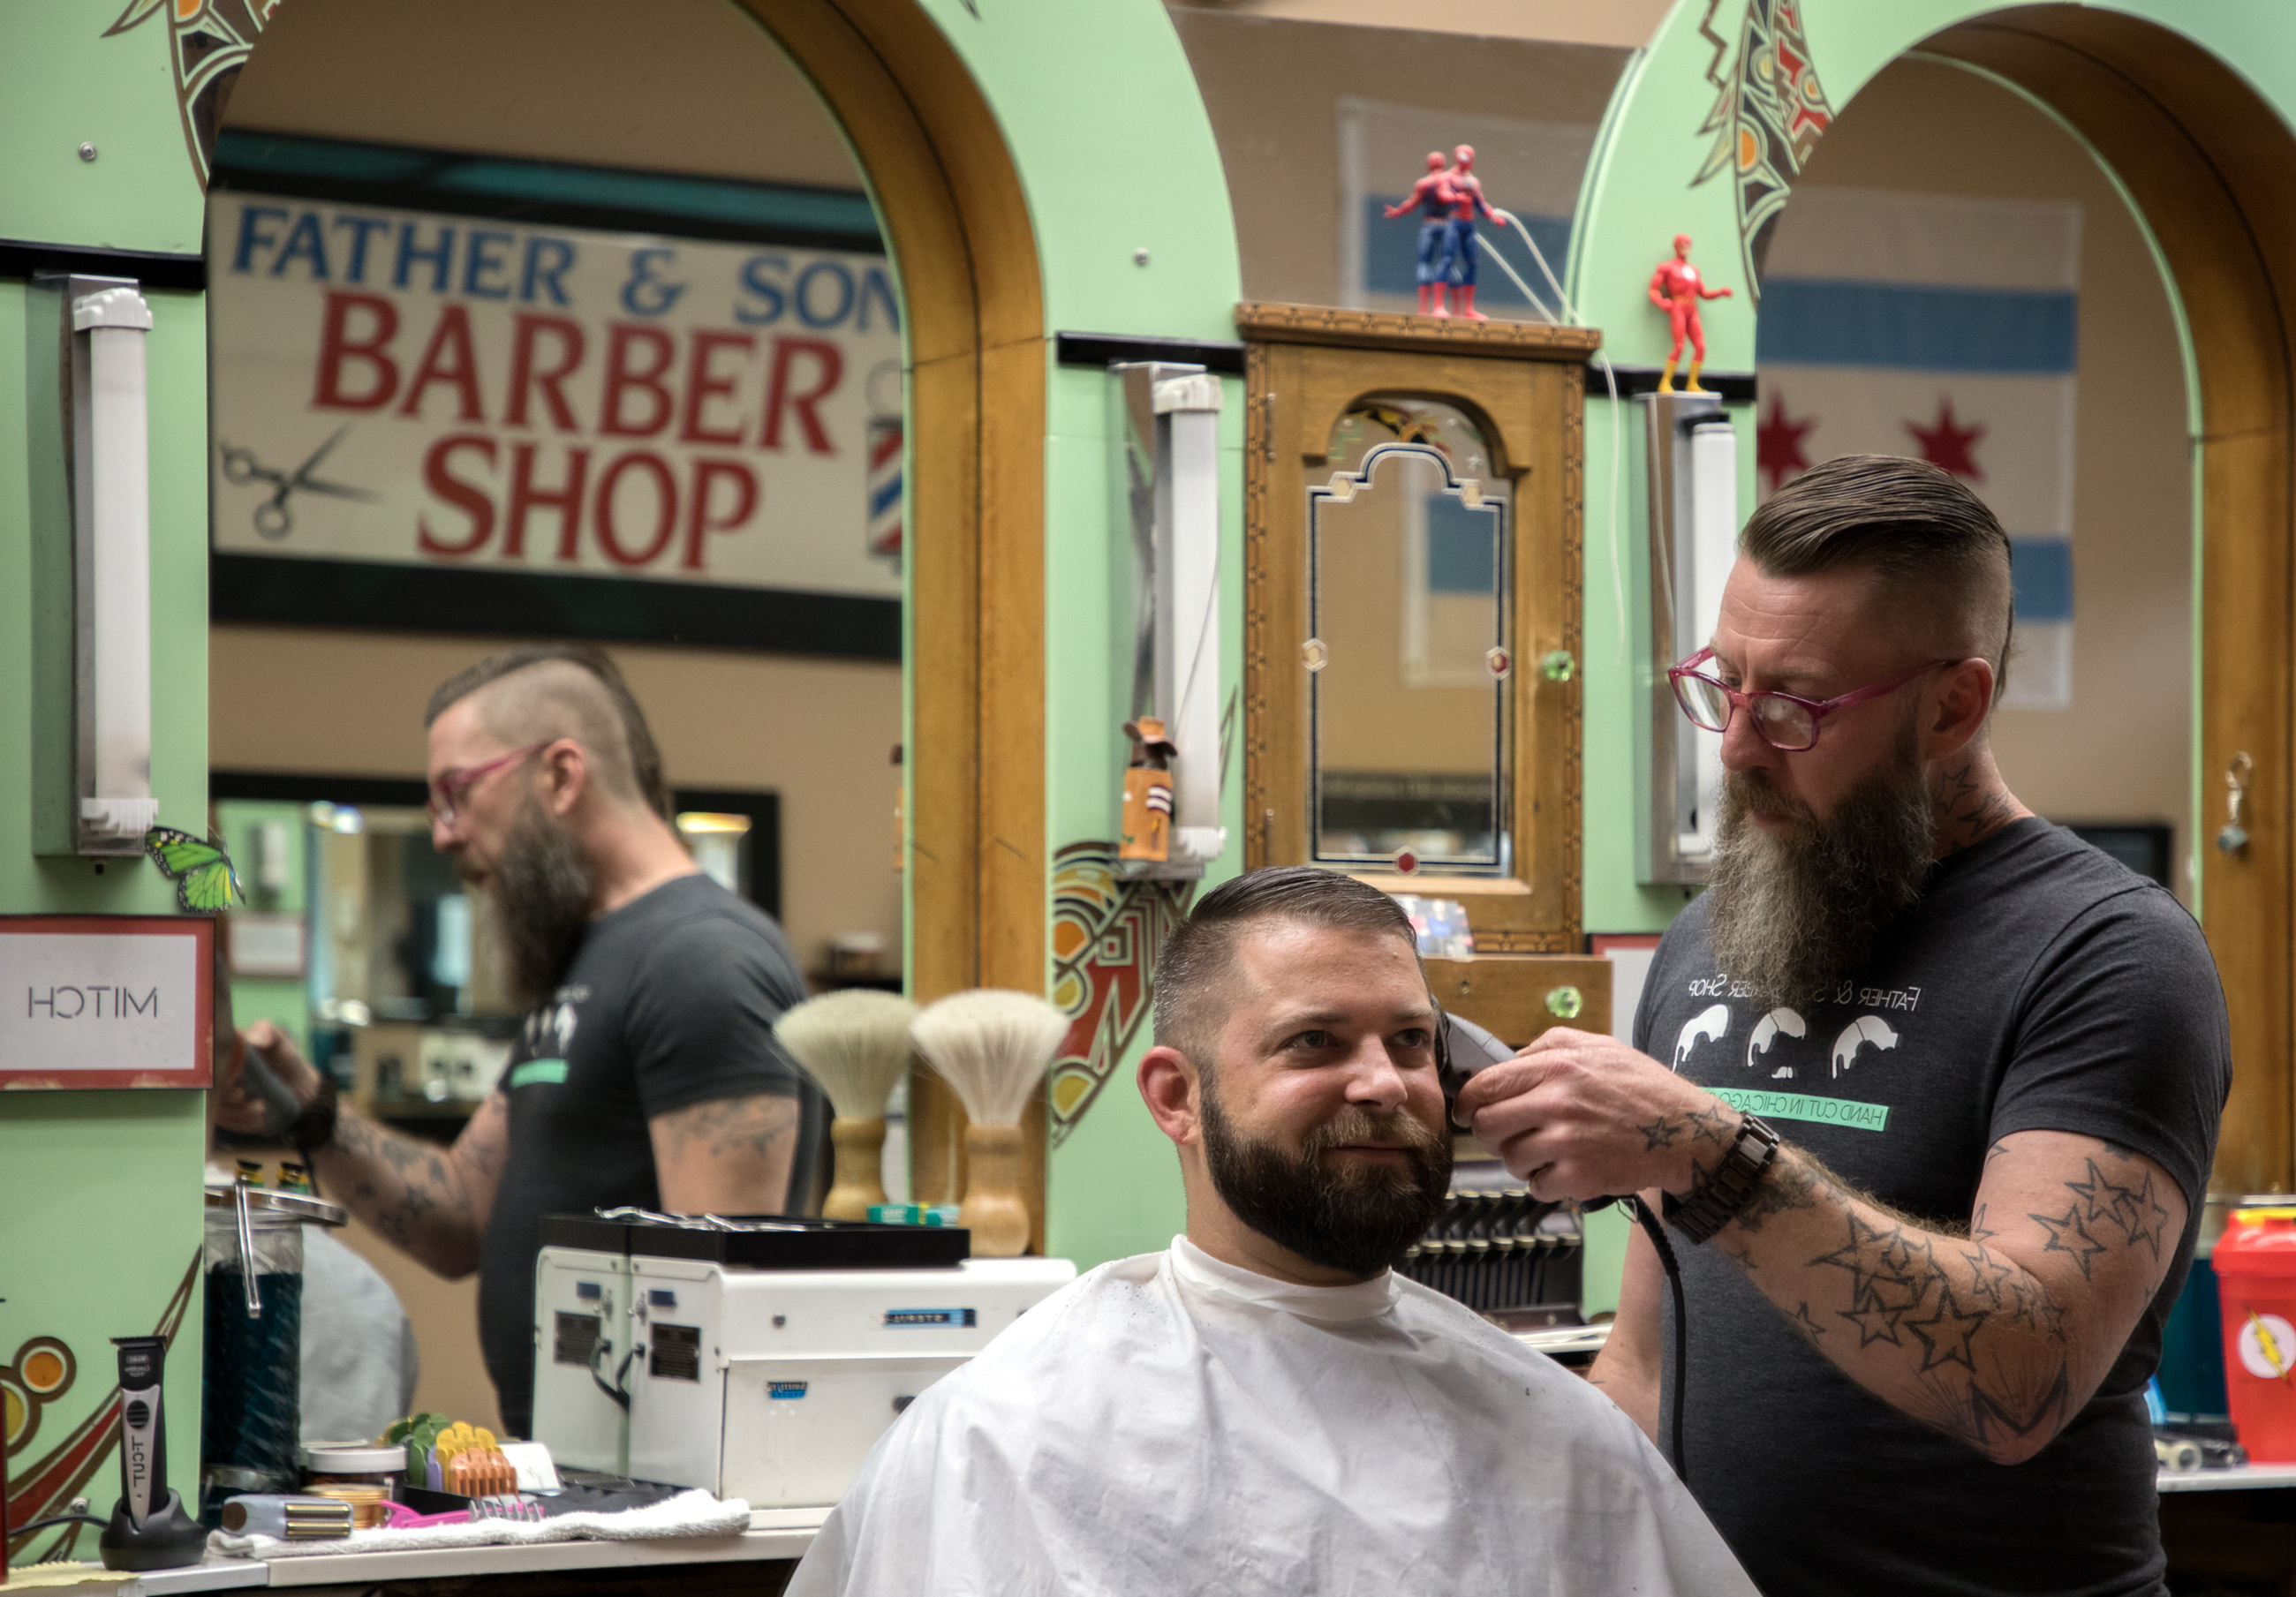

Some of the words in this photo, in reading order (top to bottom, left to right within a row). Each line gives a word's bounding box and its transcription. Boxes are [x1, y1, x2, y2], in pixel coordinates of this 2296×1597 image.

[233, 207, 578, 307] FATHER
[621, 248, 688, 317] &
[311, 290, 843, 457] BARBER
[417, 432, 762, 571] SHOP
